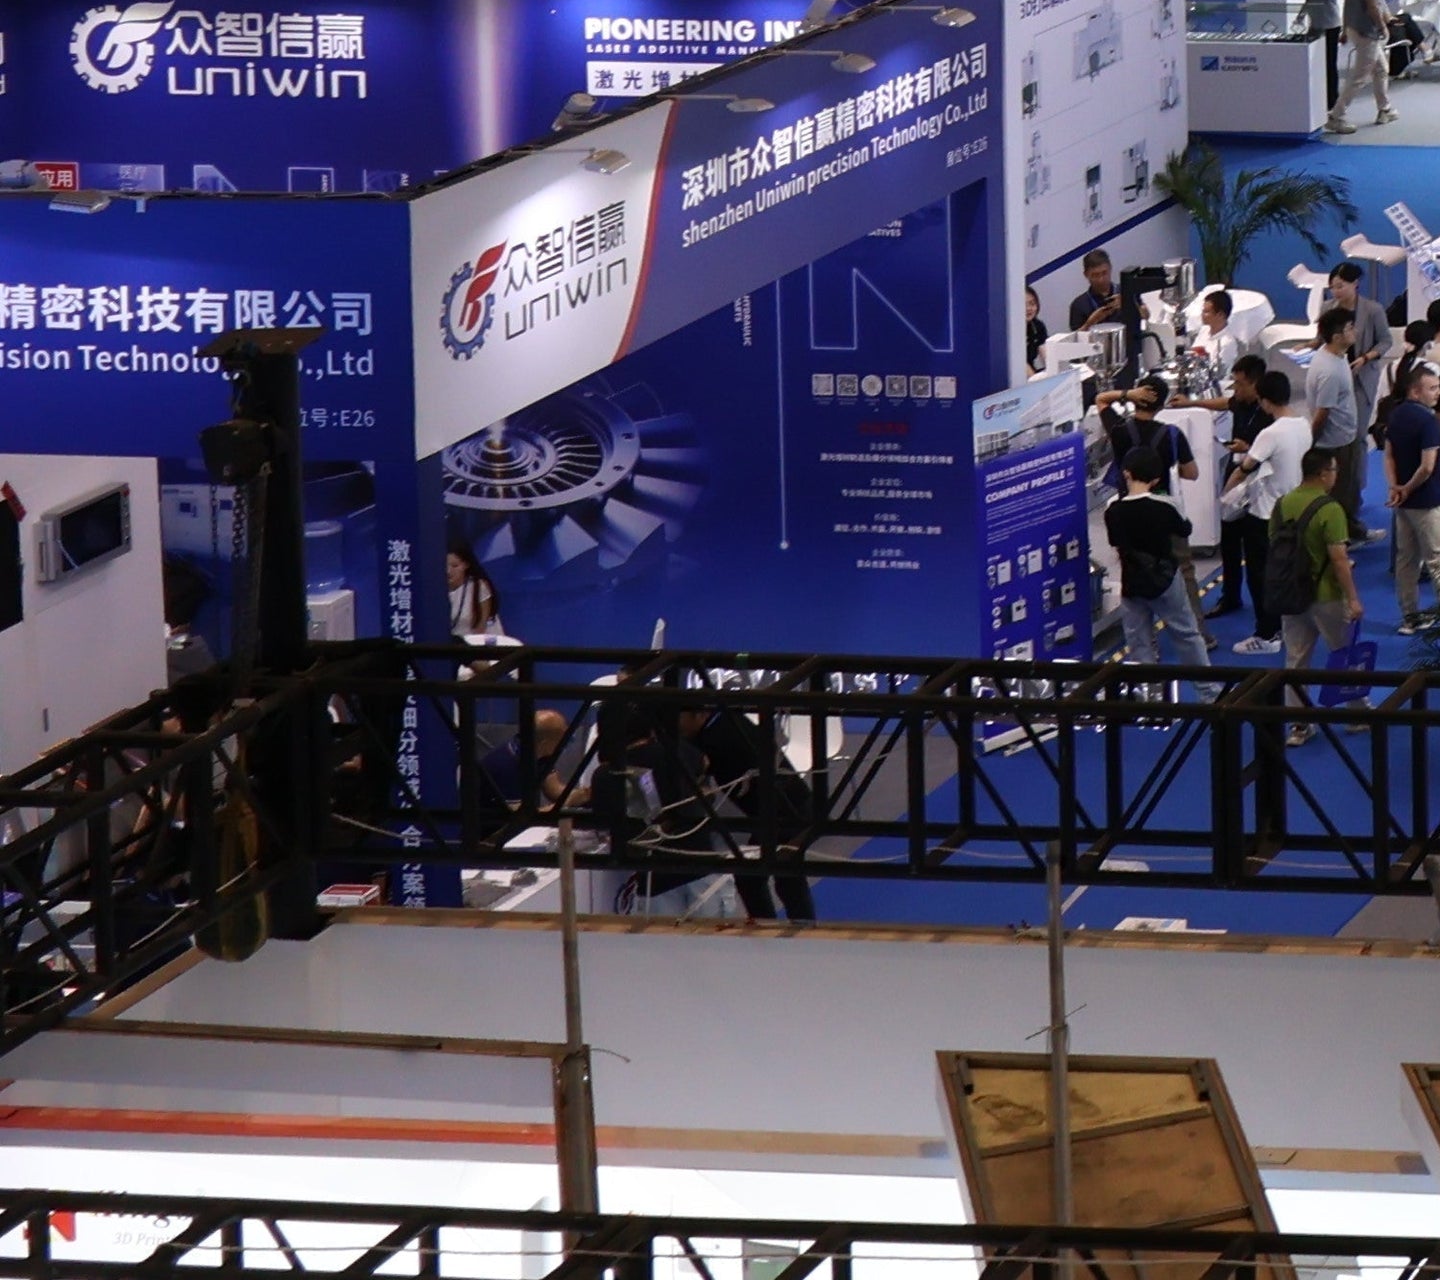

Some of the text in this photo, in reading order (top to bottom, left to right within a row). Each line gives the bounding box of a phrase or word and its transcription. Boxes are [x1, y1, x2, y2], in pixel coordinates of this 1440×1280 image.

[165, 9, 366, 60] 众智信赢
[585, 17, 757, 43] PIONEERING
[586, 45, 709, 56] LASER ADDITIVE
[682, 42, 988, 211] 深圳市众智信赢精密科技有限公司
[682, 201, 754, 249] shenzhen
[755, 174, 806, 214] Uniwin
[807, 145, 870, 194] precision
[870, 112, 943, 160] Technology
[502, 200, 626, 298] 众智信赢
